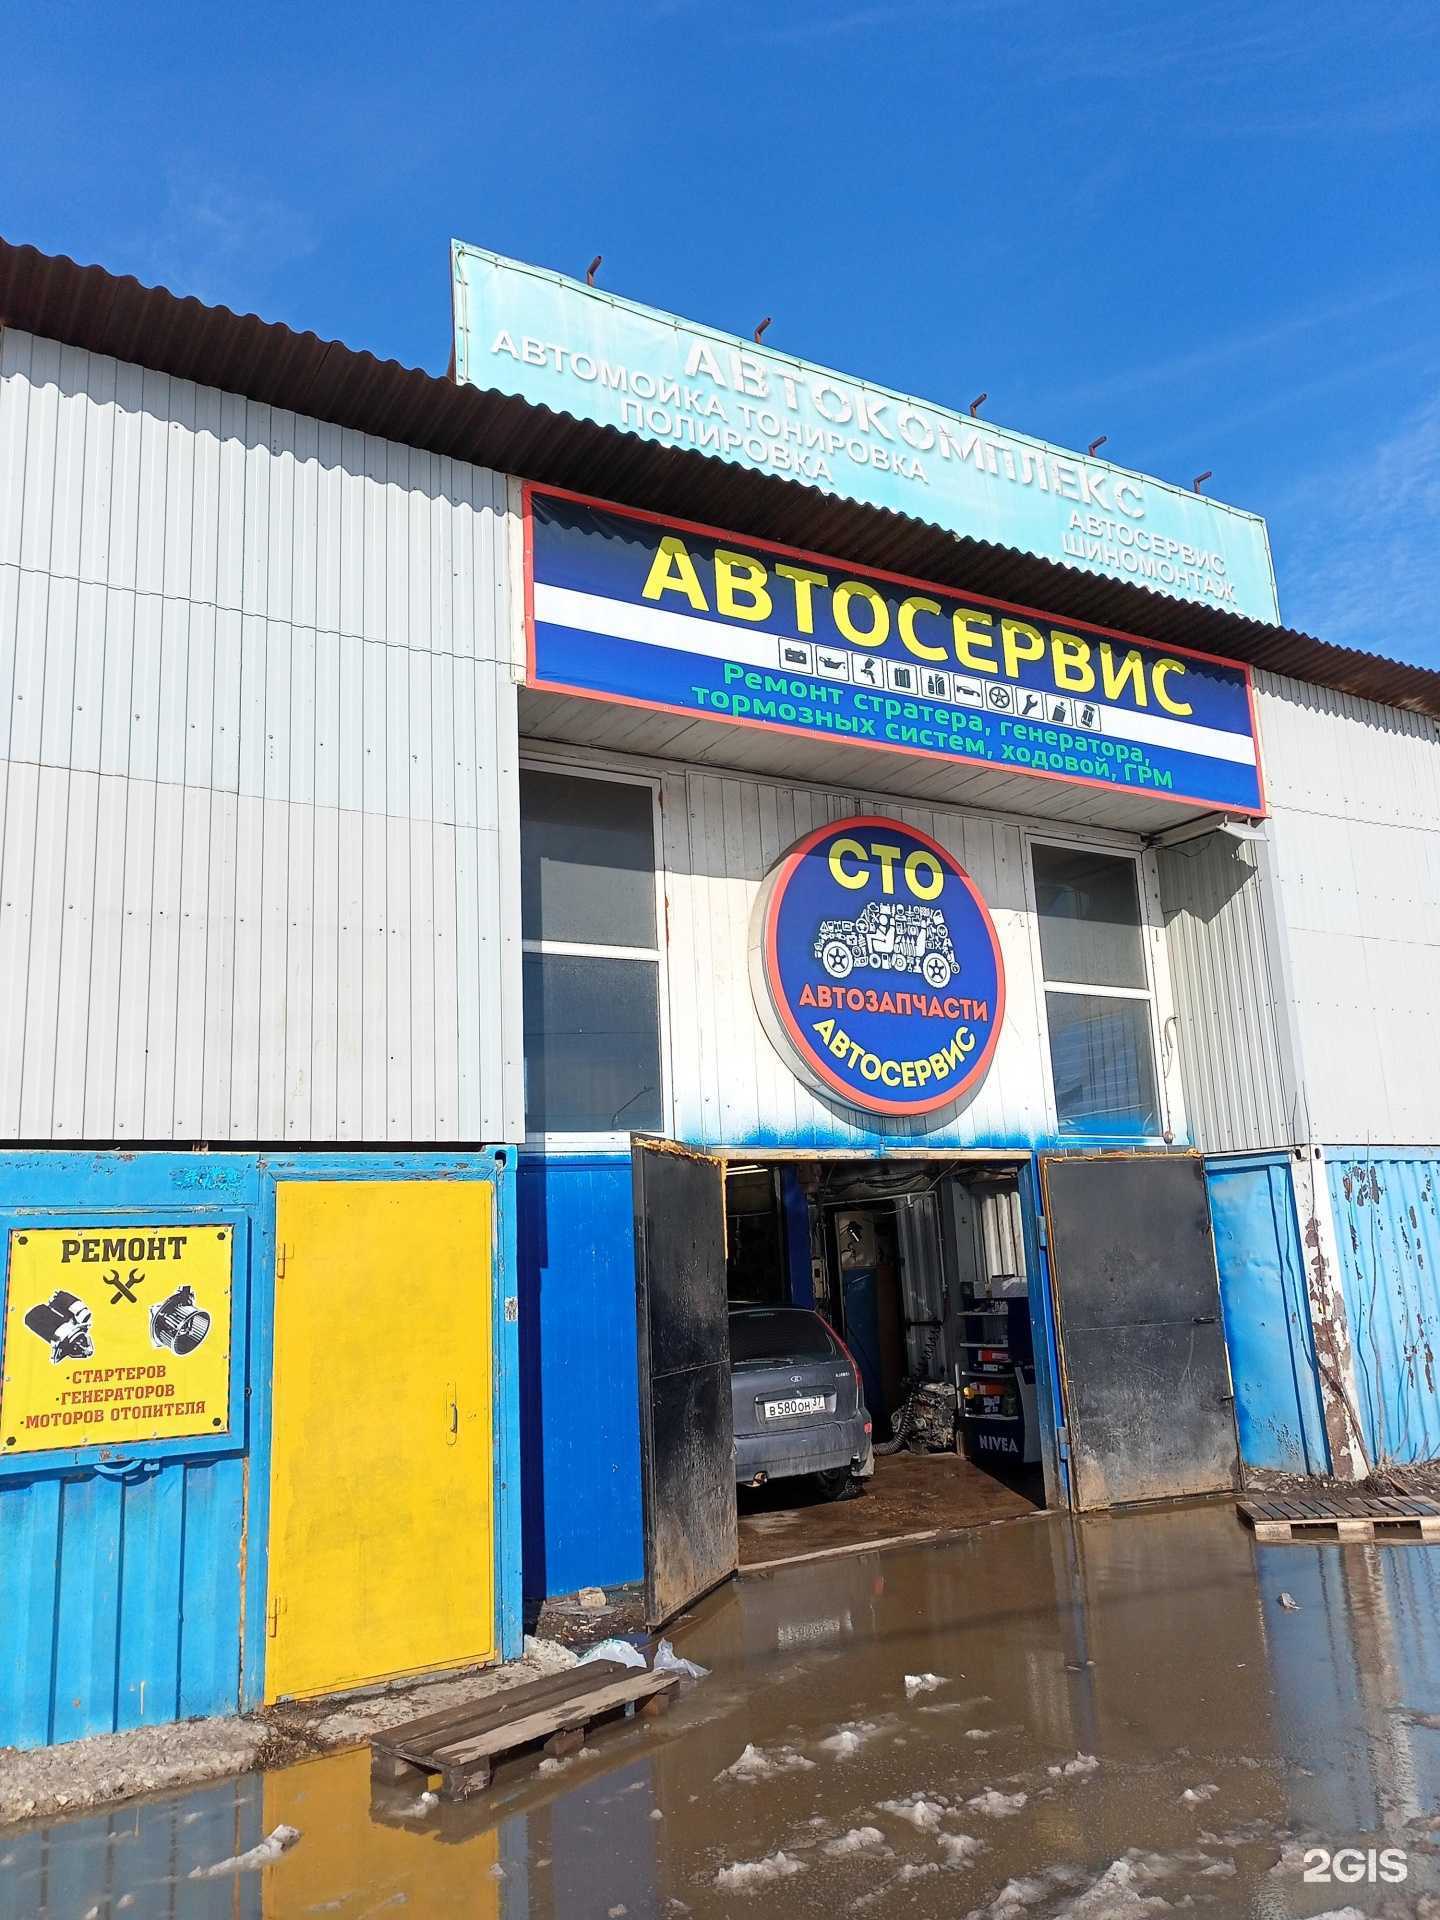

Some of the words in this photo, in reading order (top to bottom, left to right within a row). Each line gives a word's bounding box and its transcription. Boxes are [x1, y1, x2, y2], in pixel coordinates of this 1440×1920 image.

[490, 329, 729, 423] АВТОМОЙКА
[736, 403, 929, 485] ТОНИРОВКА
[621, 400, 834, 485] ПОЛИРОВКА
[684, 338, 1146, 519] АВТОКОМПЛЕКС
[1062, 532, 1237, 605] ШИНОМОНТАЖ
[1070, 508, 1226, 576] АВТОСЕРВИС
[641, 535, 1194, 717] АВТОСЕРВИС
[691, 685, 877, 736] тормозных
[885, 722, 993, 761] систем,
[1001, 742, 1116, 783] ходовой,
[1124, 763, 1174, 789] ГРМ
[723, 662, 845, 705] Ремонт
[854, 692, 991, 736] стратера,
[1000, 717, 1151, 766] генератора,
[828, 838, 944, 901] СТО
[799, 983, 989, 1022] АВТОЗАПЧАСТИ
[812, 1017, 976, 1088] АВТОСЕРВИС
[61, 1236, 187, 1263] РЕМОНТ
[110, 1400, 206, 1422] ОТОПИТЕЛЯ
[979, 1434, 1019, 1453] NIVEA
